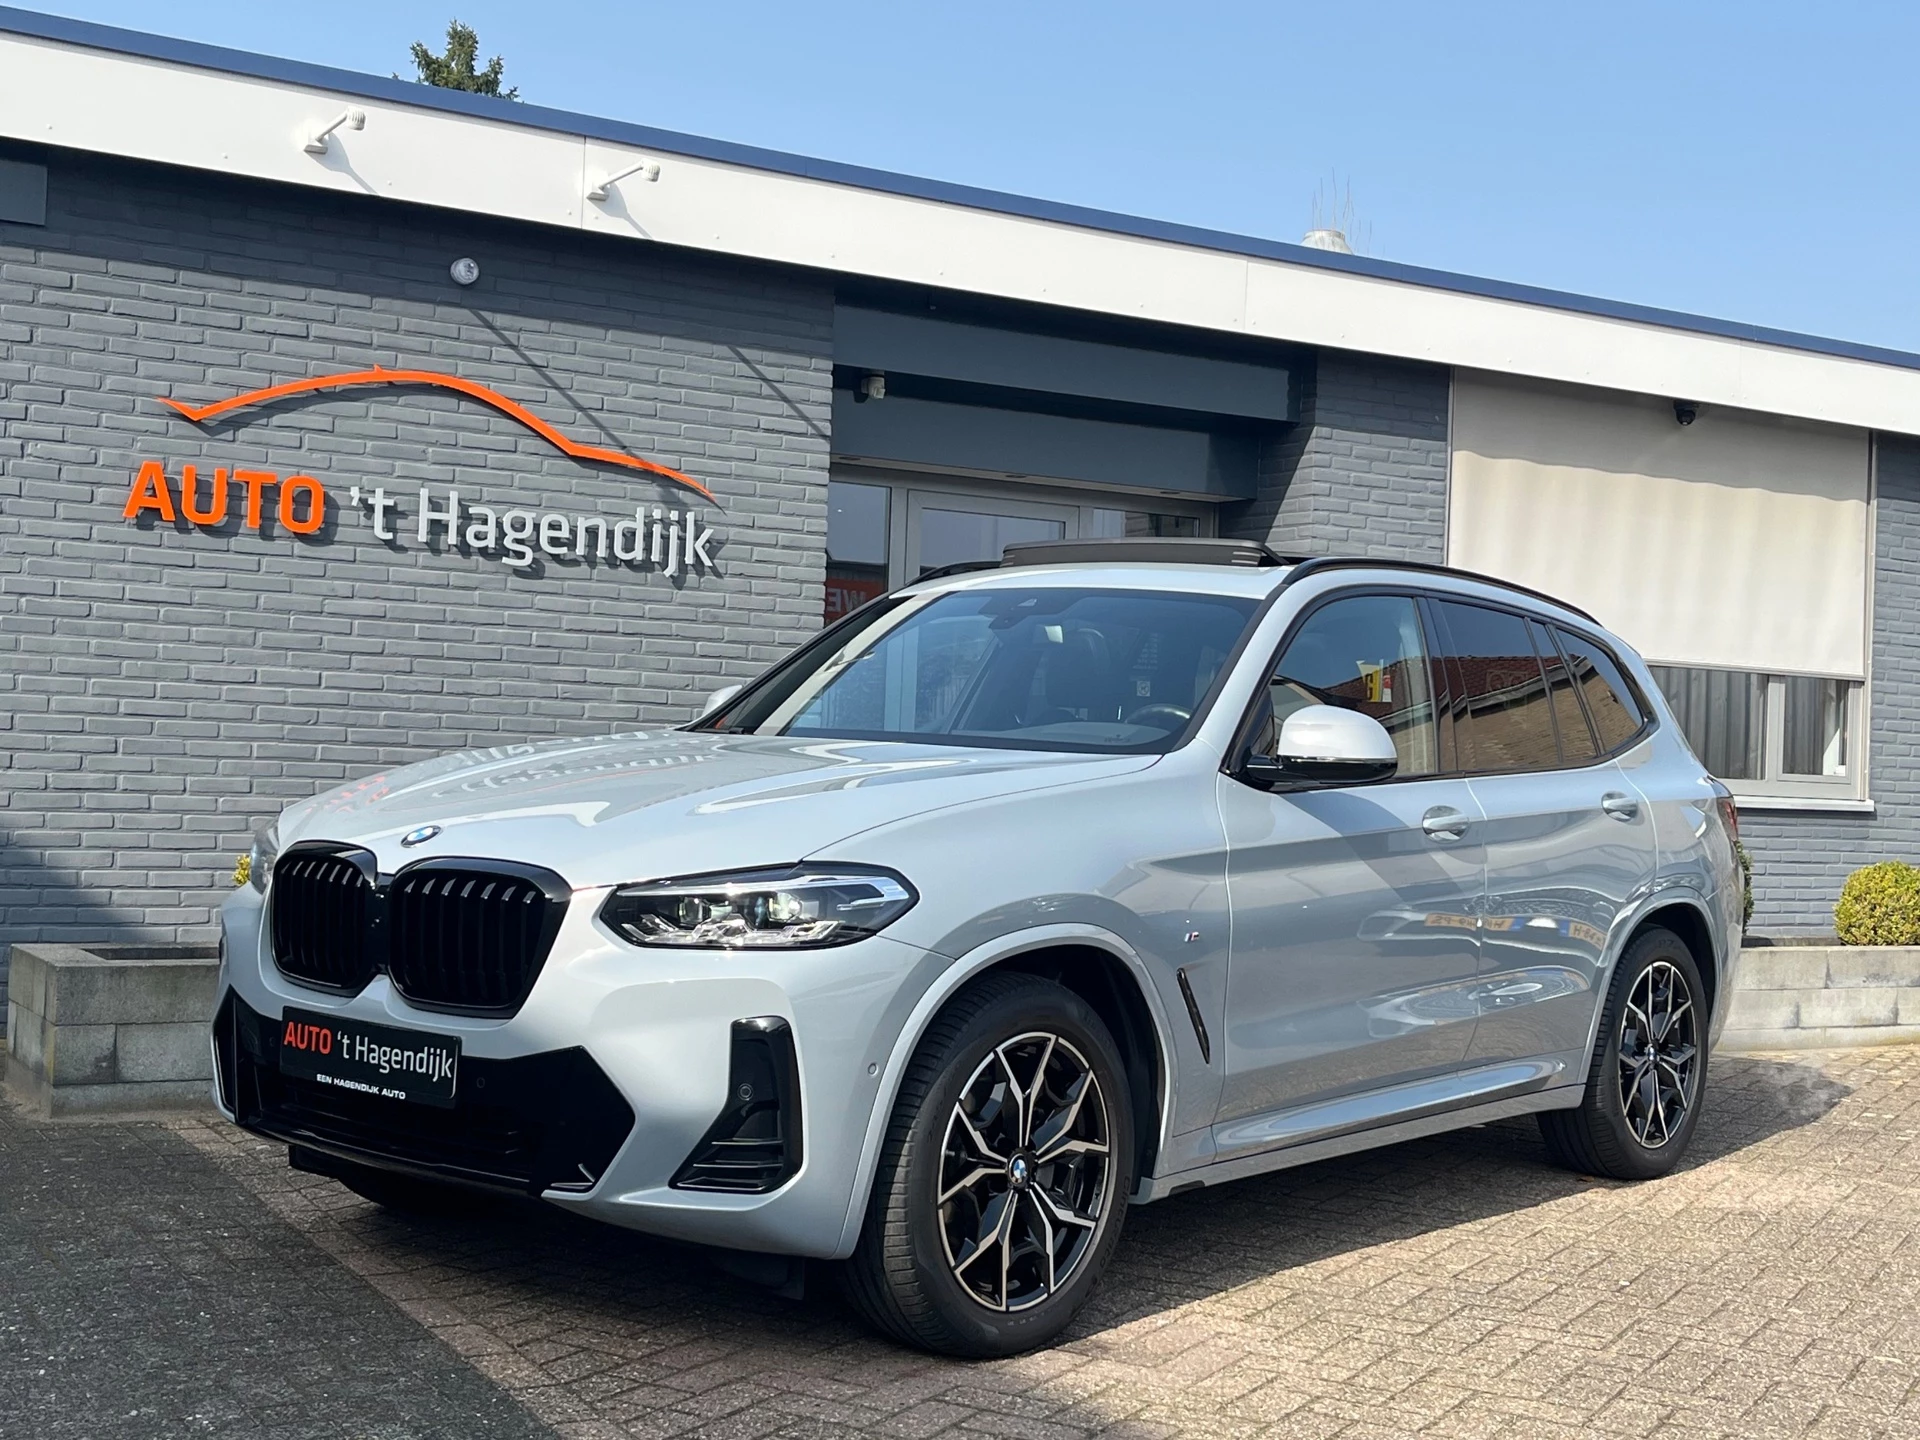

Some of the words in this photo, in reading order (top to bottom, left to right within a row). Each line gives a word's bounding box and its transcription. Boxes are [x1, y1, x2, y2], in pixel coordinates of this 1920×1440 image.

[122, 460, 326, 535] AUTO
[417, 487, 715, 578] Hagendijk
[284, 1021, 332, 1055] AUTO
[355, 1035, 453, 1083] Hagendijk
[316, 1073, 332, 1085] EEN
[333, 1077, 380, 1095] HAGENDIJK
[381, 1088, 406, 1100] AUTO
